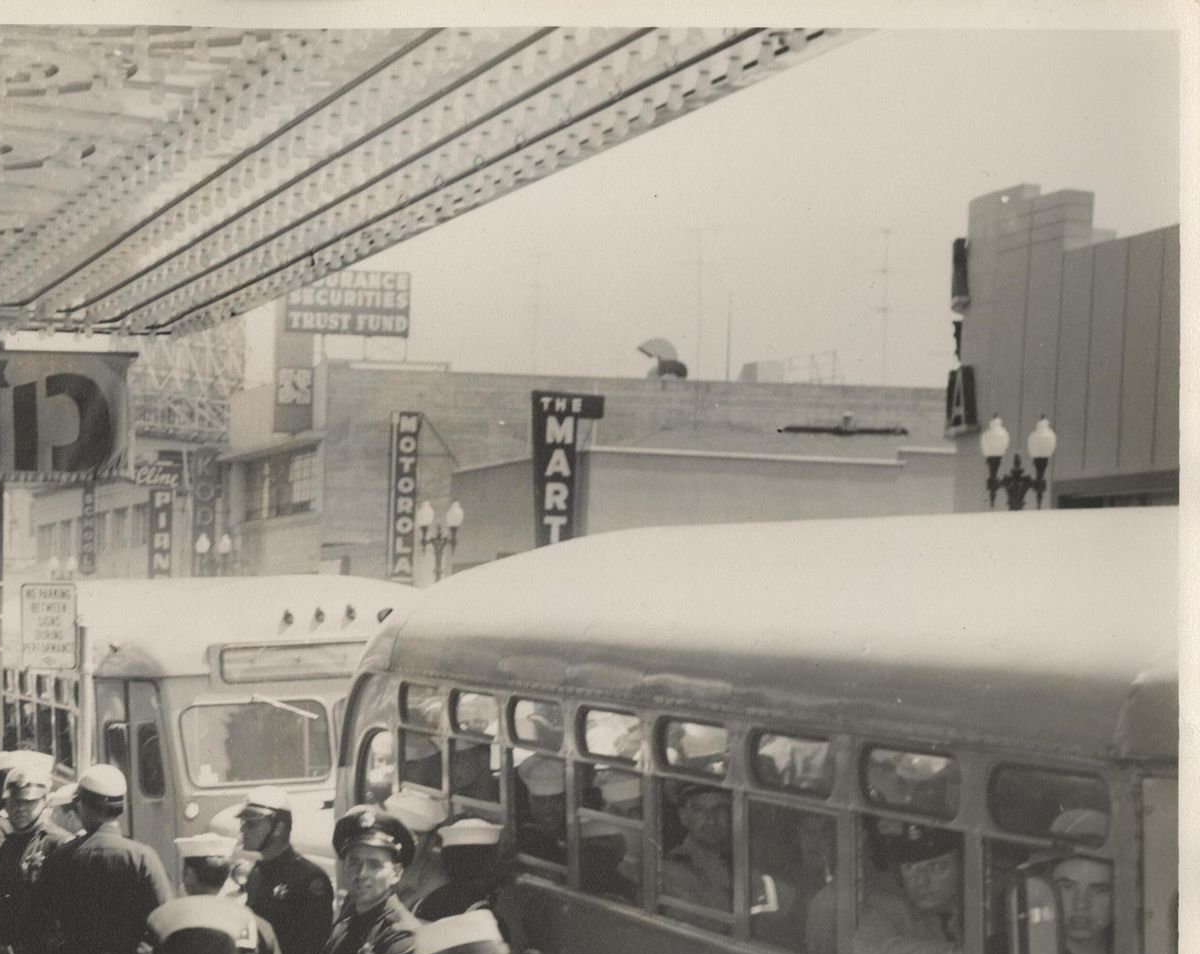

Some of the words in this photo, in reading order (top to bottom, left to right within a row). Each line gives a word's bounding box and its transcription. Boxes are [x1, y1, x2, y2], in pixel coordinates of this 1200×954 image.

[312, 271, 409, 290] URANCE
[288, 288, 408, 309] SECURITIES
[289, 311, 352, 330] TRUST
[356, 314, 408, 332] FUND
[540, 396, 583, 413] THE
[135, 465, 180, 488] Cline
[543, 415, 574, 545] MART
[394, 414, 418, 574] MOTOROLA
[153, 491, 171, 578] PIAN
